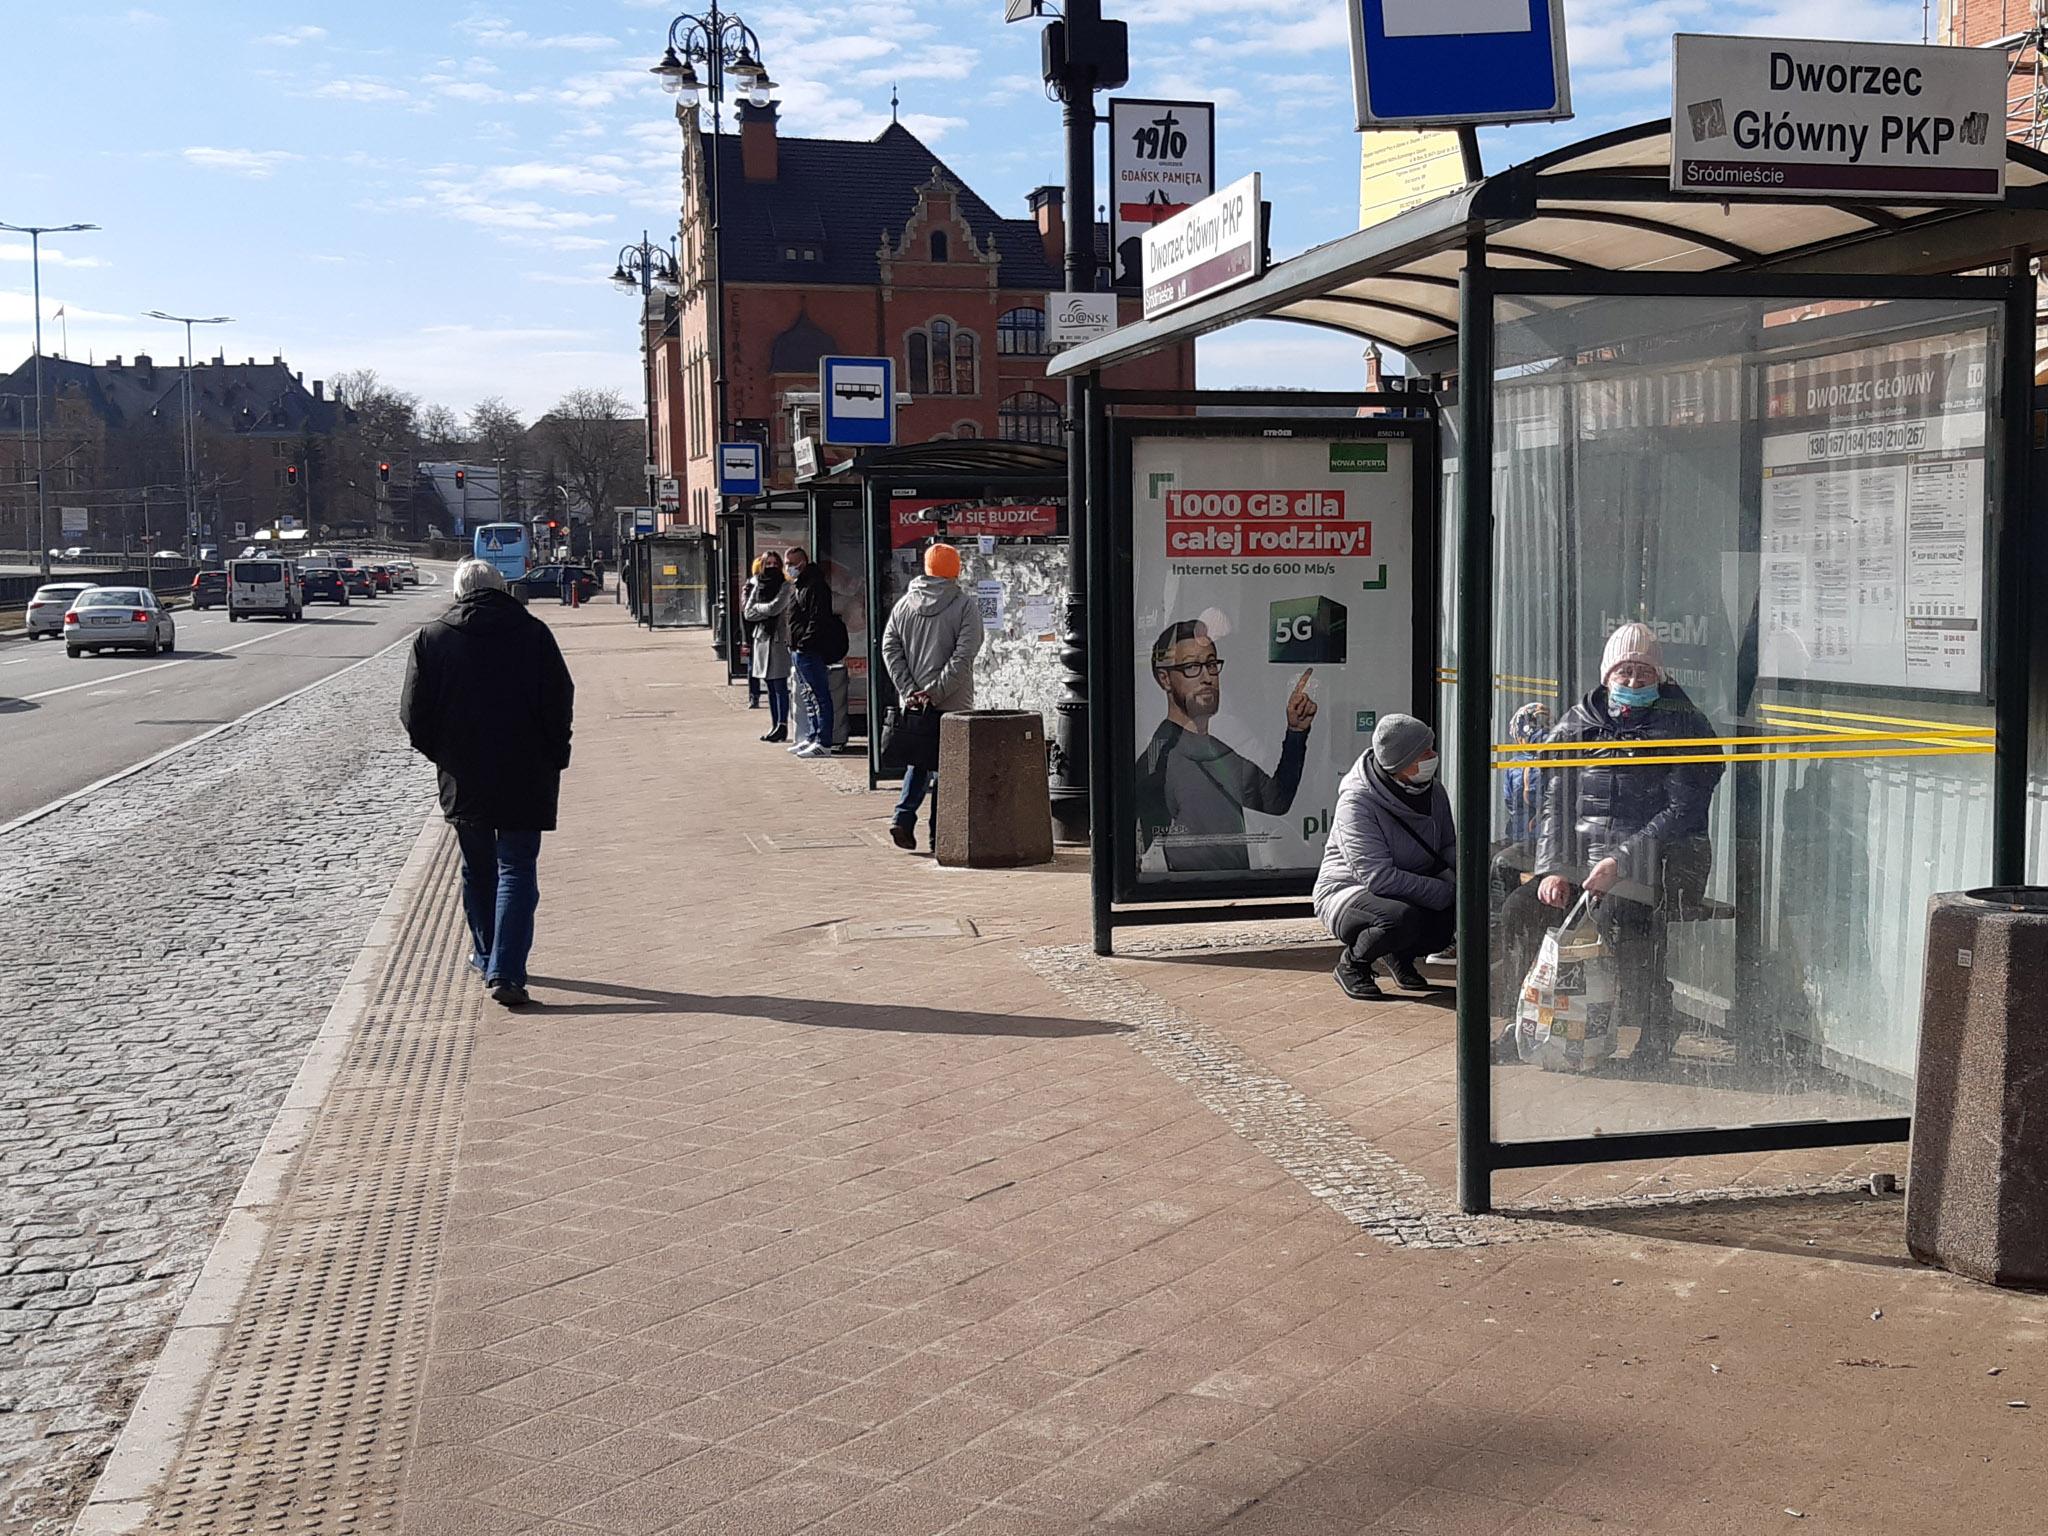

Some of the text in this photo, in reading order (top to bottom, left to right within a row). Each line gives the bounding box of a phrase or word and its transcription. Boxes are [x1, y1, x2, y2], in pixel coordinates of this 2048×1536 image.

[1770, 52, 1922, 96] Dworzec
[1733, 110, 1954, 162] Główny PKP
[1121, 168, 1203, 186] GDAŃSK PAMIĘTA
[1686, 162, 1785, 184] Śródmieście
[1150, 195, 1243, 274] Dworzec Główny PKP
[1807, 370, 1935, 410] DWORZEC GŁÓWNY
[1907, 427, 1926, 445] 267
[1331, 459, 1386, 467] NOWA OFERTA
[1170, 493, 1339, 517] 1000 GB dla
[966, 511, 986, 525] SIĘ
[1171, 524, 1366, 556] całej rodziny!
[1172, 564, 1336, 576] Internet 5G do 600 Mb/s
[1275, 615, 1313, 643] 5G
[1358, 717, 1374, 727] 5G
